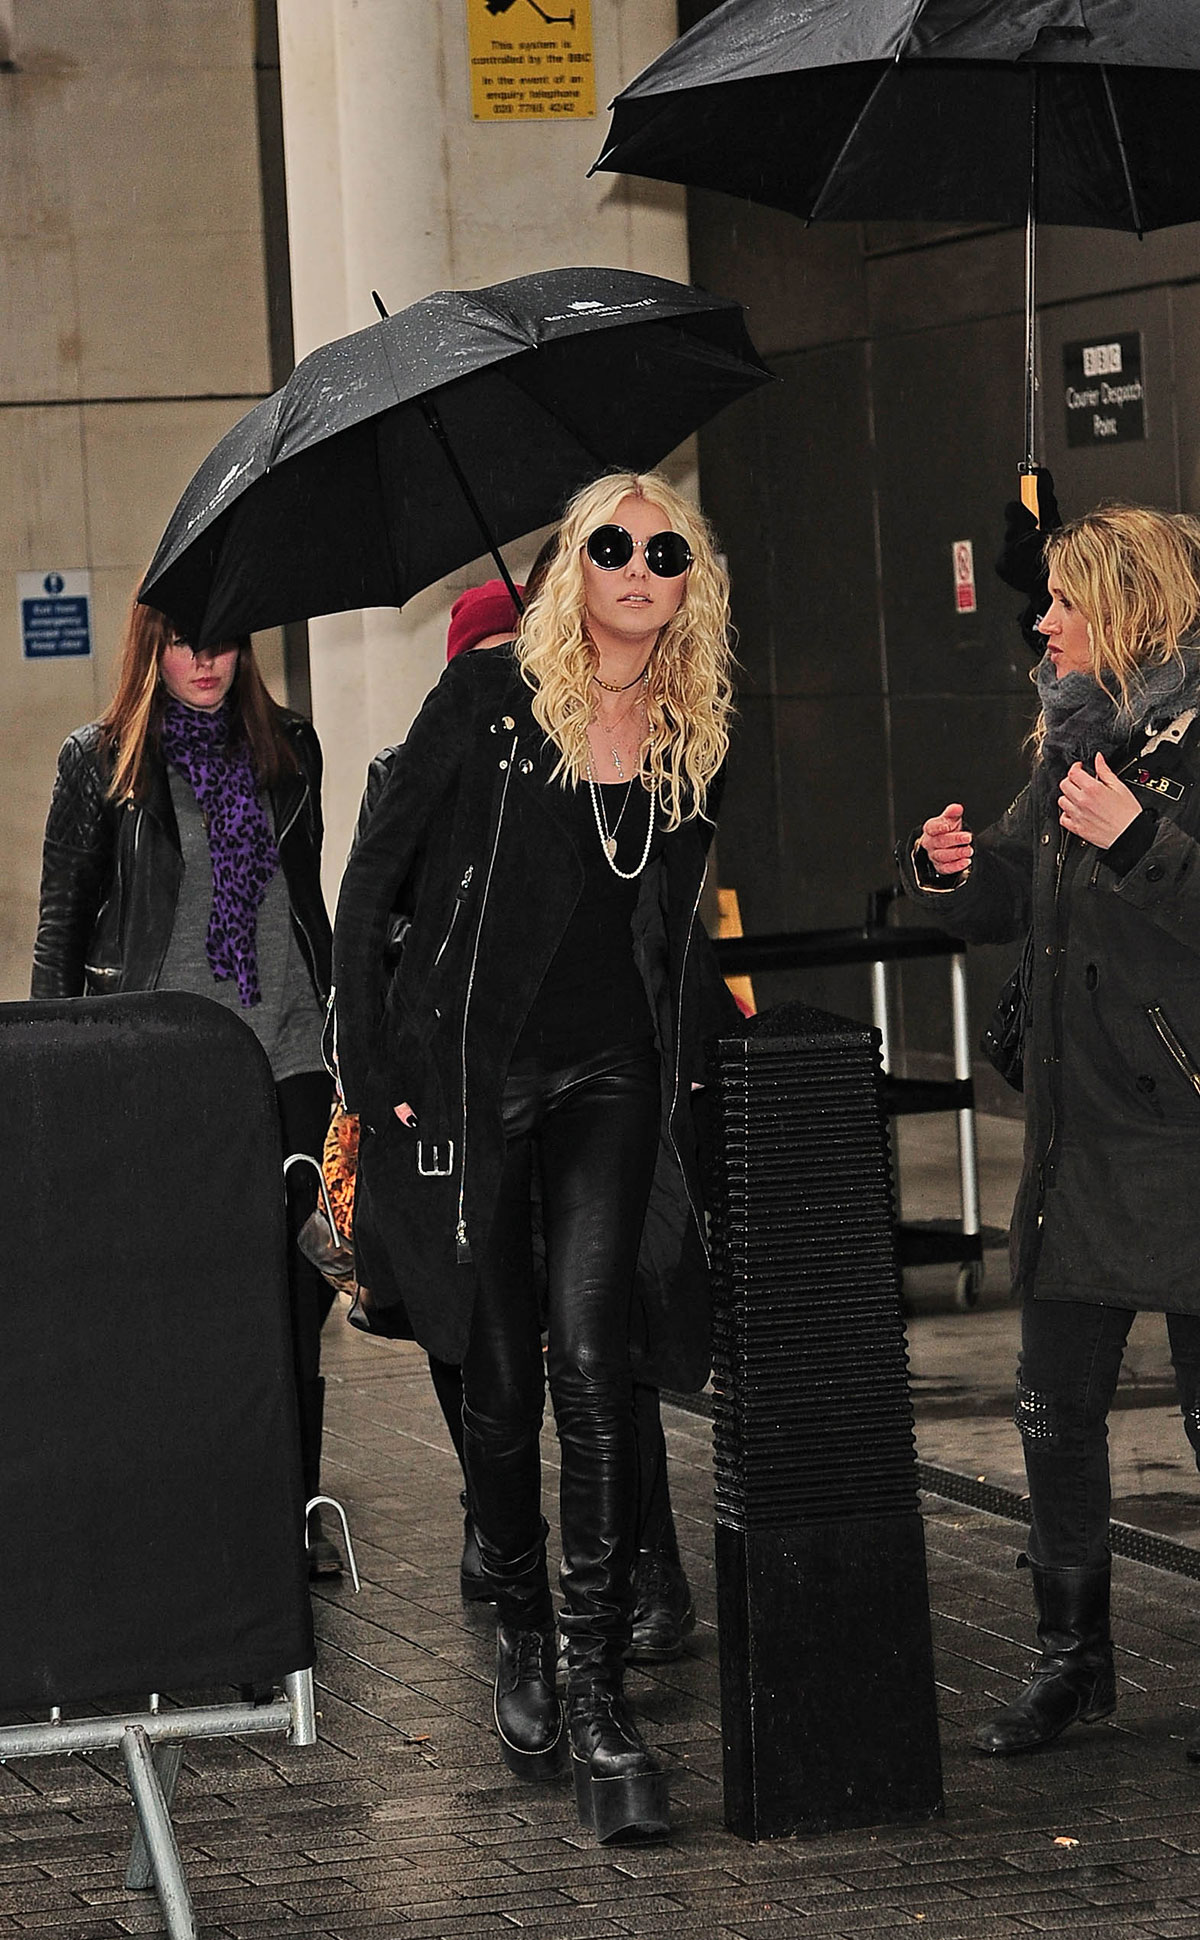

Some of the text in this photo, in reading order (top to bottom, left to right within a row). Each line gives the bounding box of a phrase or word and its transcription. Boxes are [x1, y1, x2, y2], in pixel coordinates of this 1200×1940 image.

[1066, 379, 1143, 409] Courier Despatch
[1093, 414, 1117, 436] Point
